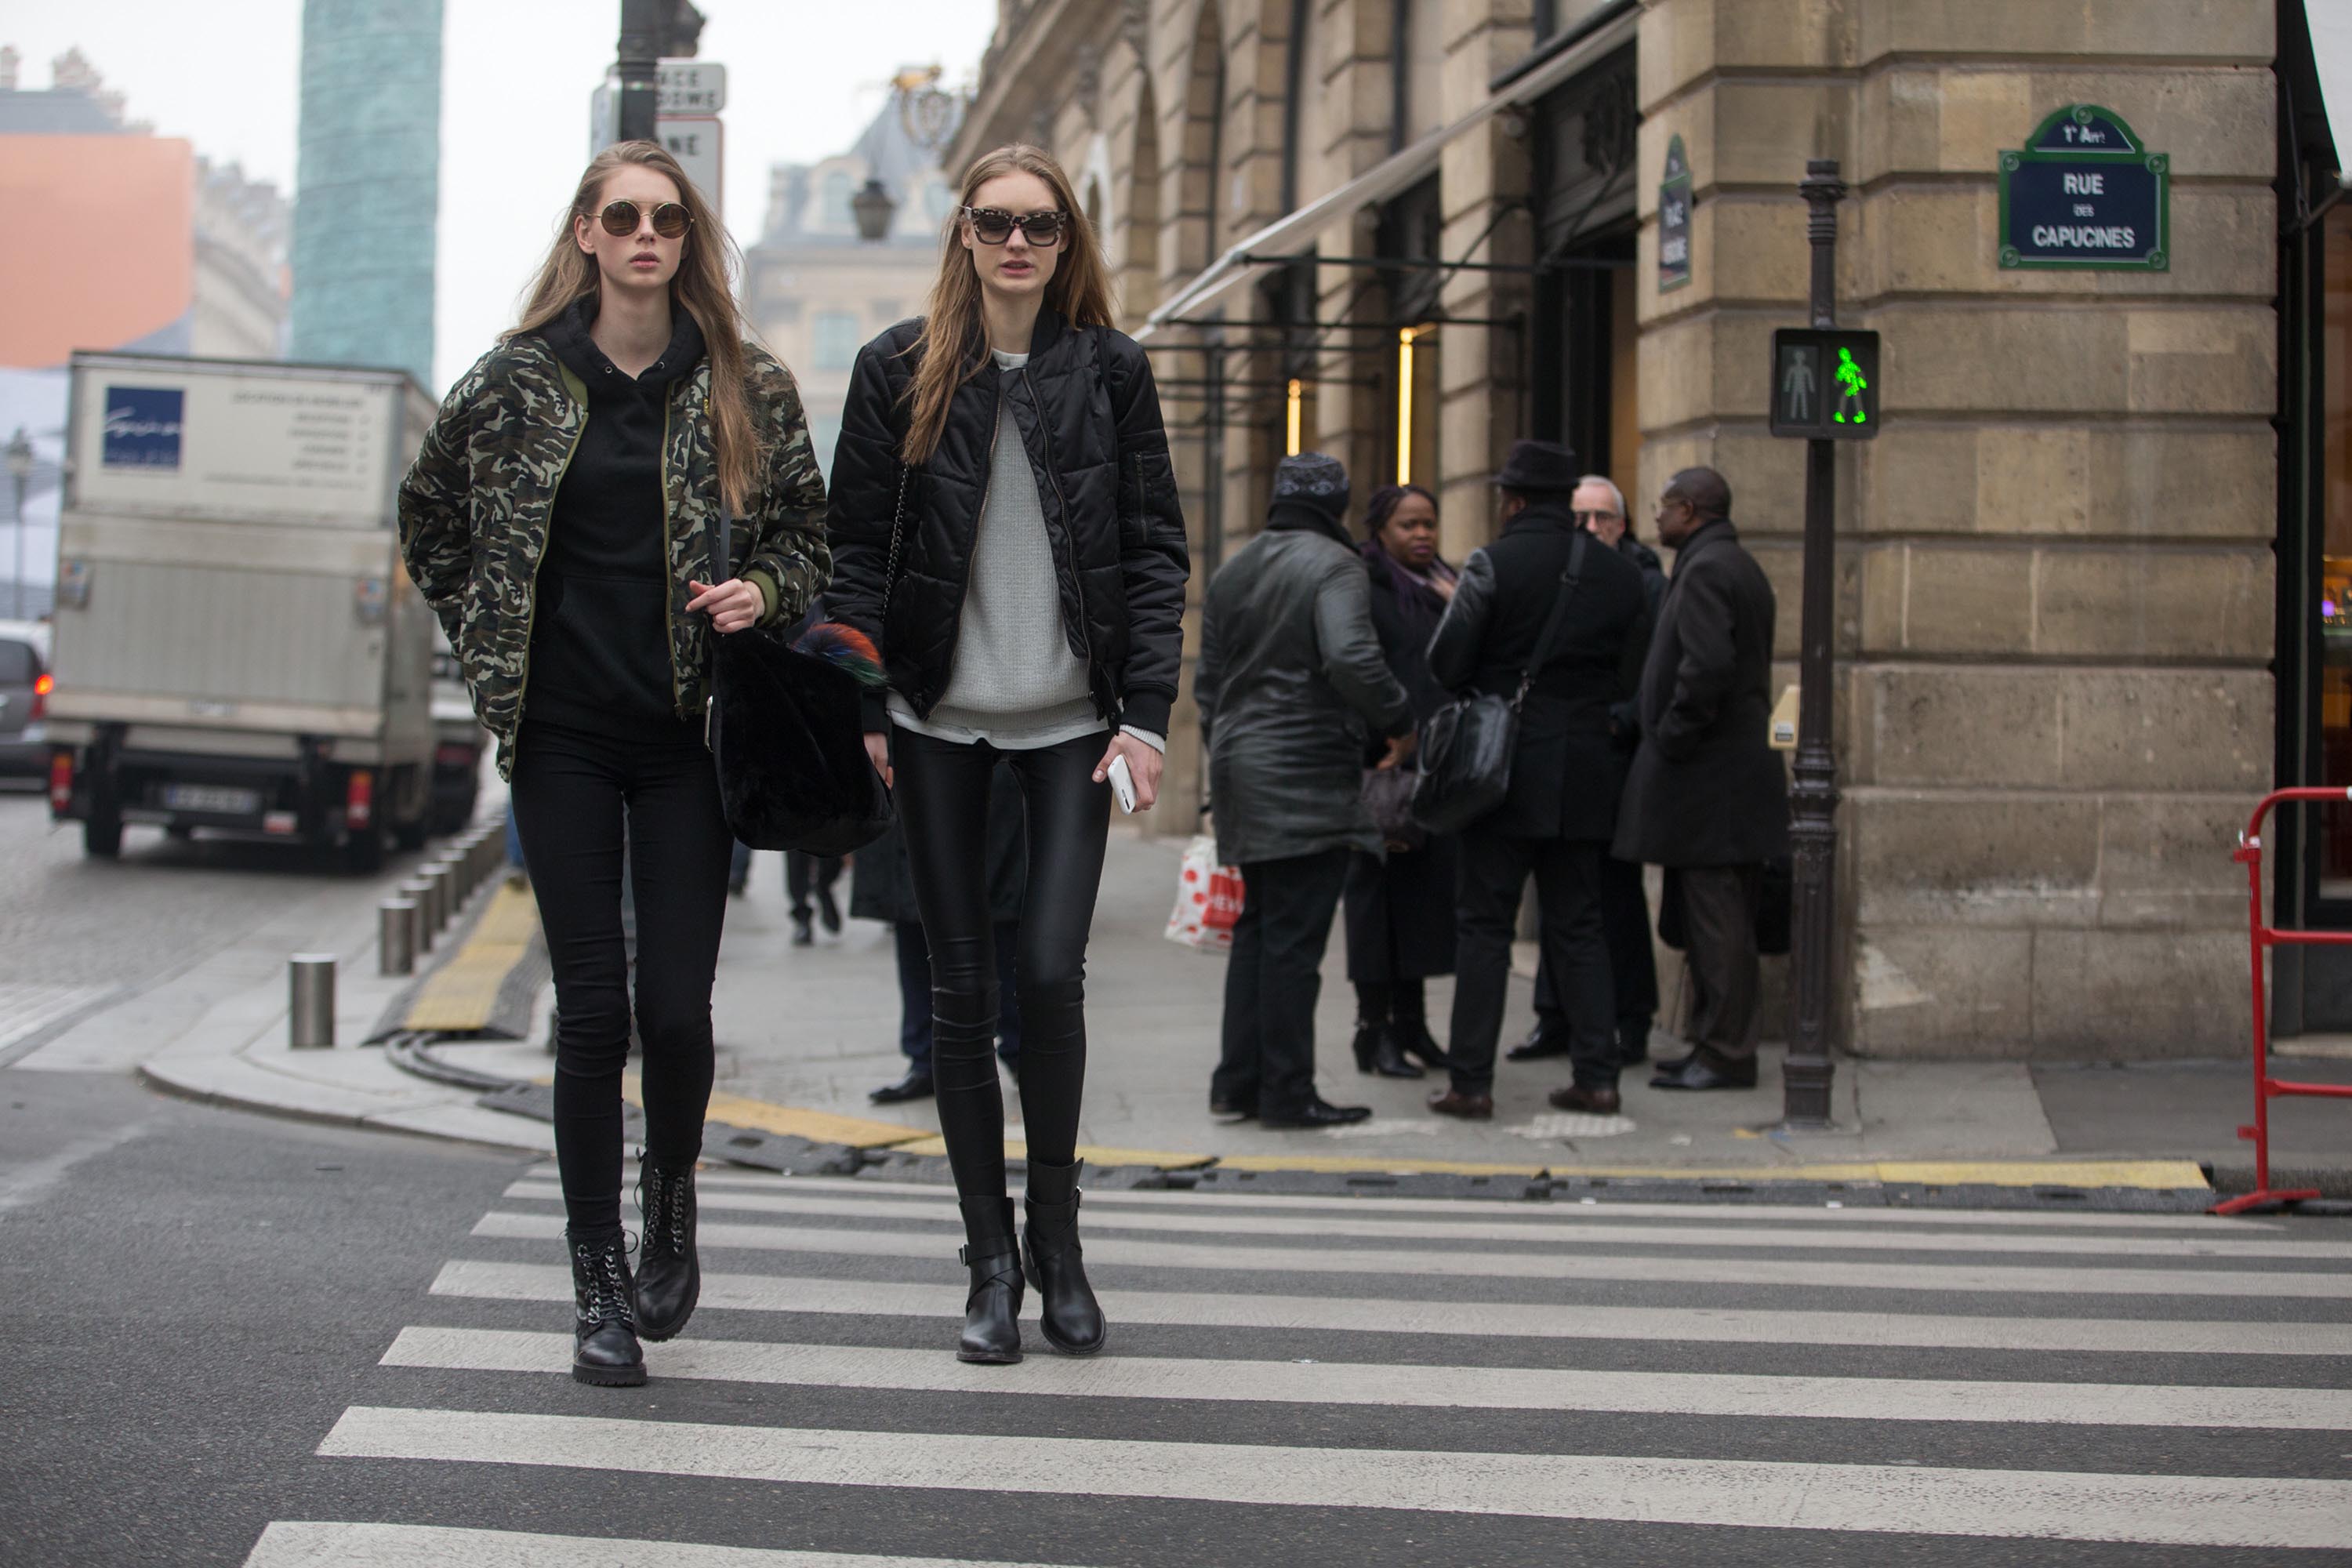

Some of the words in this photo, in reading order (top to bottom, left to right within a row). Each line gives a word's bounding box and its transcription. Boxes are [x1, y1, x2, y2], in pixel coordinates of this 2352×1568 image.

[2063, 172, 2104, 194] RUE
[2073, 204, 2095, 217] DES
[2032, 224, 2135, 248] CAPUCINES
